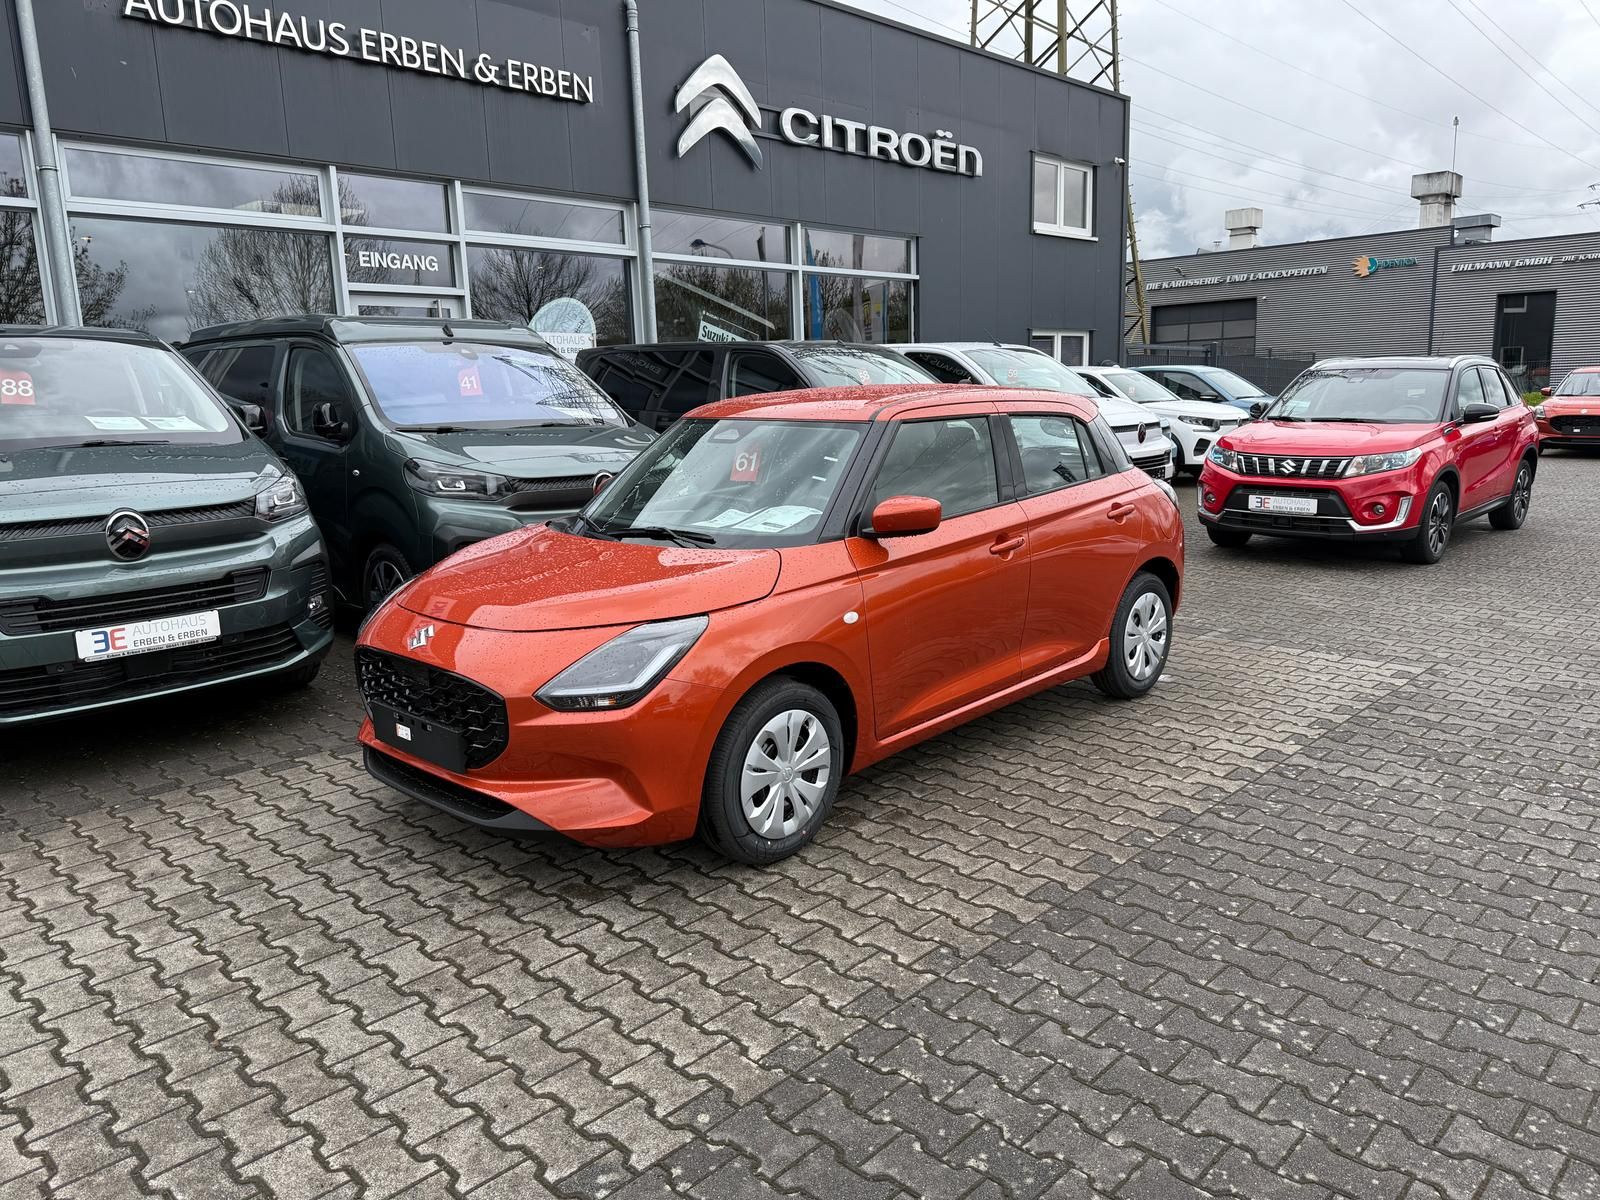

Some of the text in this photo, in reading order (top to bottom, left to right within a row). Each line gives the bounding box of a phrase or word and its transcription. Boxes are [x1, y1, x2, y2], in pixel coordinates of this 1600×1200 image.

[123, 0, 594, 104] AUTOHAUS ERBEN & ERBEN
[358, 250, 439, 272] EINGANG
[544, 335, 586, 345] UTOHAUS
[1, 378, 33, 397] 88
[461, 375, 478, 390] 41
[735, 452, 758, 472] 61
[132, 614, 207, 636] AUTOHAUS
[133, 635, 166, 648] ERBEN
[167, 633, 175, 642] &
[177, 628, 208, 640] ERBEN
